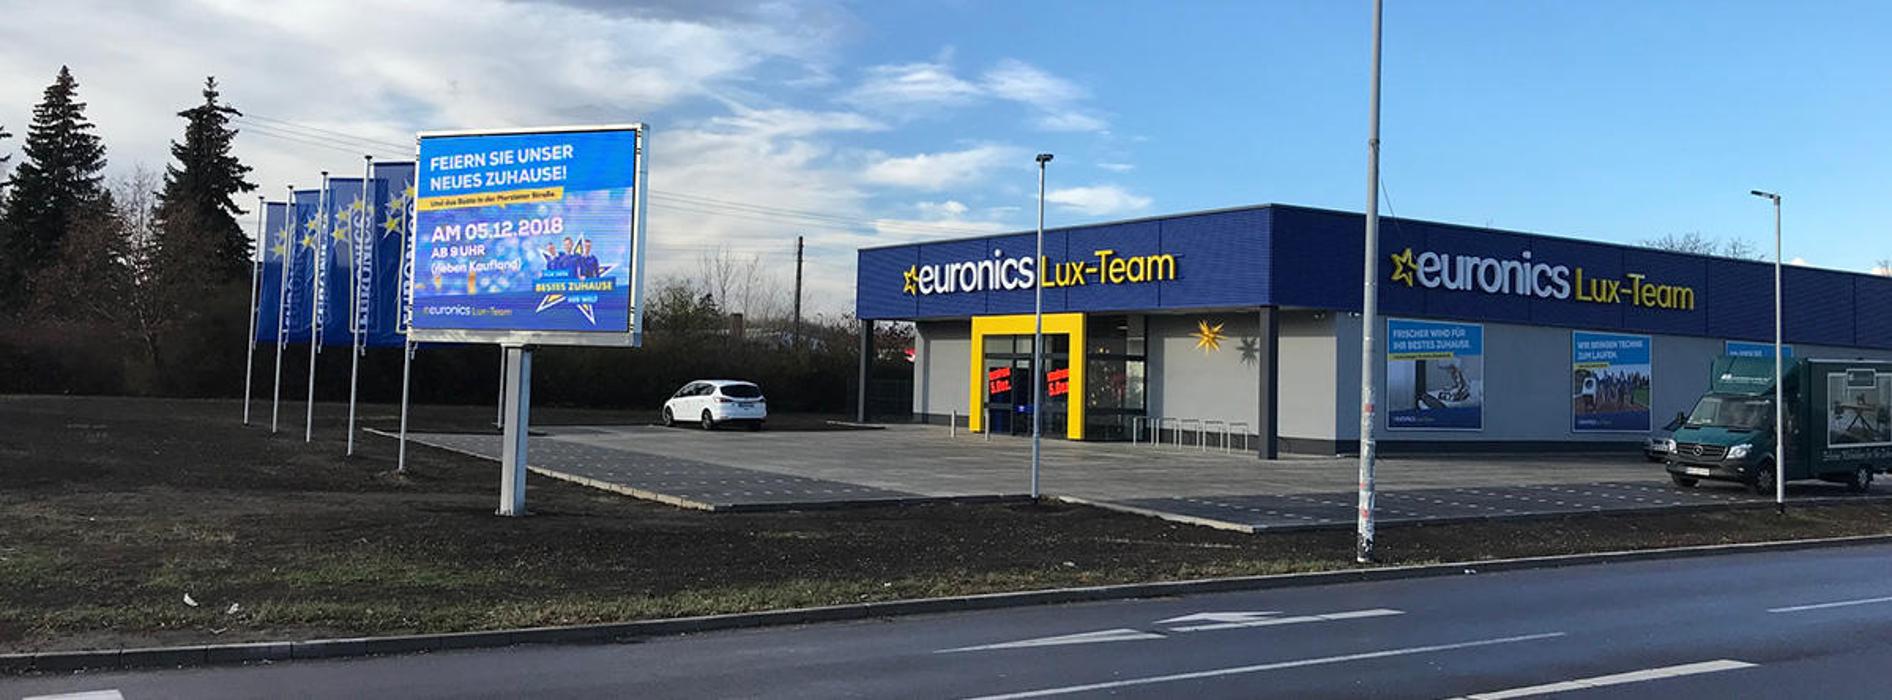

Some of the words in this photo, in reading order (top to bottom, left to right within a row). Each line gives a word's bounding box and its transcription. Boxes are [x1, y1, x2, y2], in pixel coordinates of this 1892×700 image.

[430, 152, 486, 171] FEIERN
[489, 150, 514, 166] SIE
[517, 144, 573, 164] UNSER
[430, 173, 482, 191] NEUES
[485, 165, 567, 187] ZUHAUSE!
[431, 225, 461, 242] AM
[464, 217, 563, 240] 05.12.2018
[431, 247, 448, 258] AB
[449, 246, 458, 256] 9
[459, 244, 486, 256] UHR
[469, 258, 521, 272] Kaufland)
[918, 249, 1035, 295] euronics
[1040, 249, 1176, 287] Lux-Team
[568, 280, 612, 291] ZUHAUSE
[1417, 251, 1570, 299] euronics
[1574, 267, 1695, 310] Lux-Team
[429, 303, 471, 316] euronics
